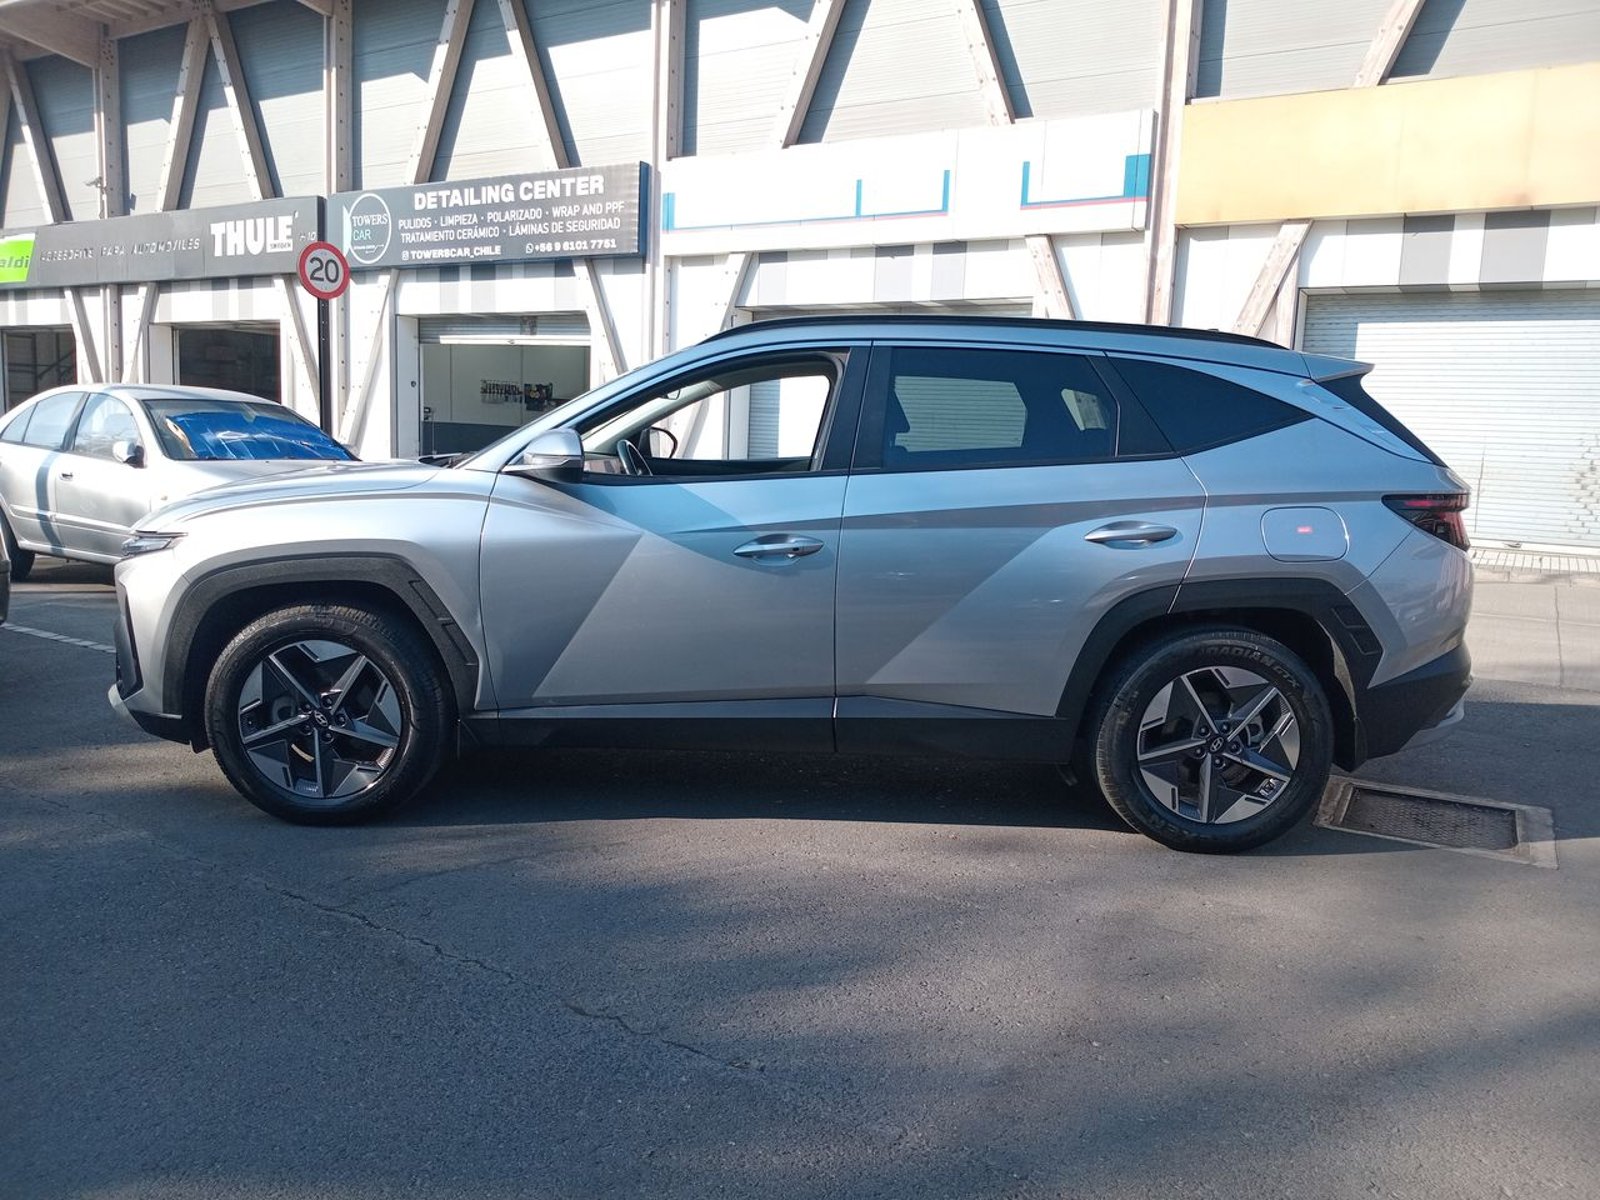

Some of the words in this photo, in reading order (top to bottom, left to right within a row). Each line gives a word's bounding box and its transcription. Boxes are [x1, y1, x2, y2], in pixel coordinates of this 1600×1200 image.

[414, 183, 515, 210] DETAILING
[519, 174, 605, 201] CENTER
[352, 213, 388, 227] TOWERS
[398, 216, 432, 230] PULIDOS
[440, 213, 478, 227] LIMPIEZA
[487, 208, 543, 223] POLARIZADO
[552, 204, 581, 218] WRAP
[582, 202, 603, 216] AND
[605, 200, 625, 214] PPF
[210, 215, 293, 257] THULE
[353, 229, 372, 241] CAR
[400, 230, 455, 244] TRATAMIENTO
[456, 226, 500, 240] CERÁMICO
[509, 221, 549, 236] LÁMINAS
[551, 221, 564, 234] DE
[566, 217, 621, 232] SEGURIDAD
[410, 245, 502, 260] TOWERSCAR_CHILE
[309, 256, 340, 284] 20
